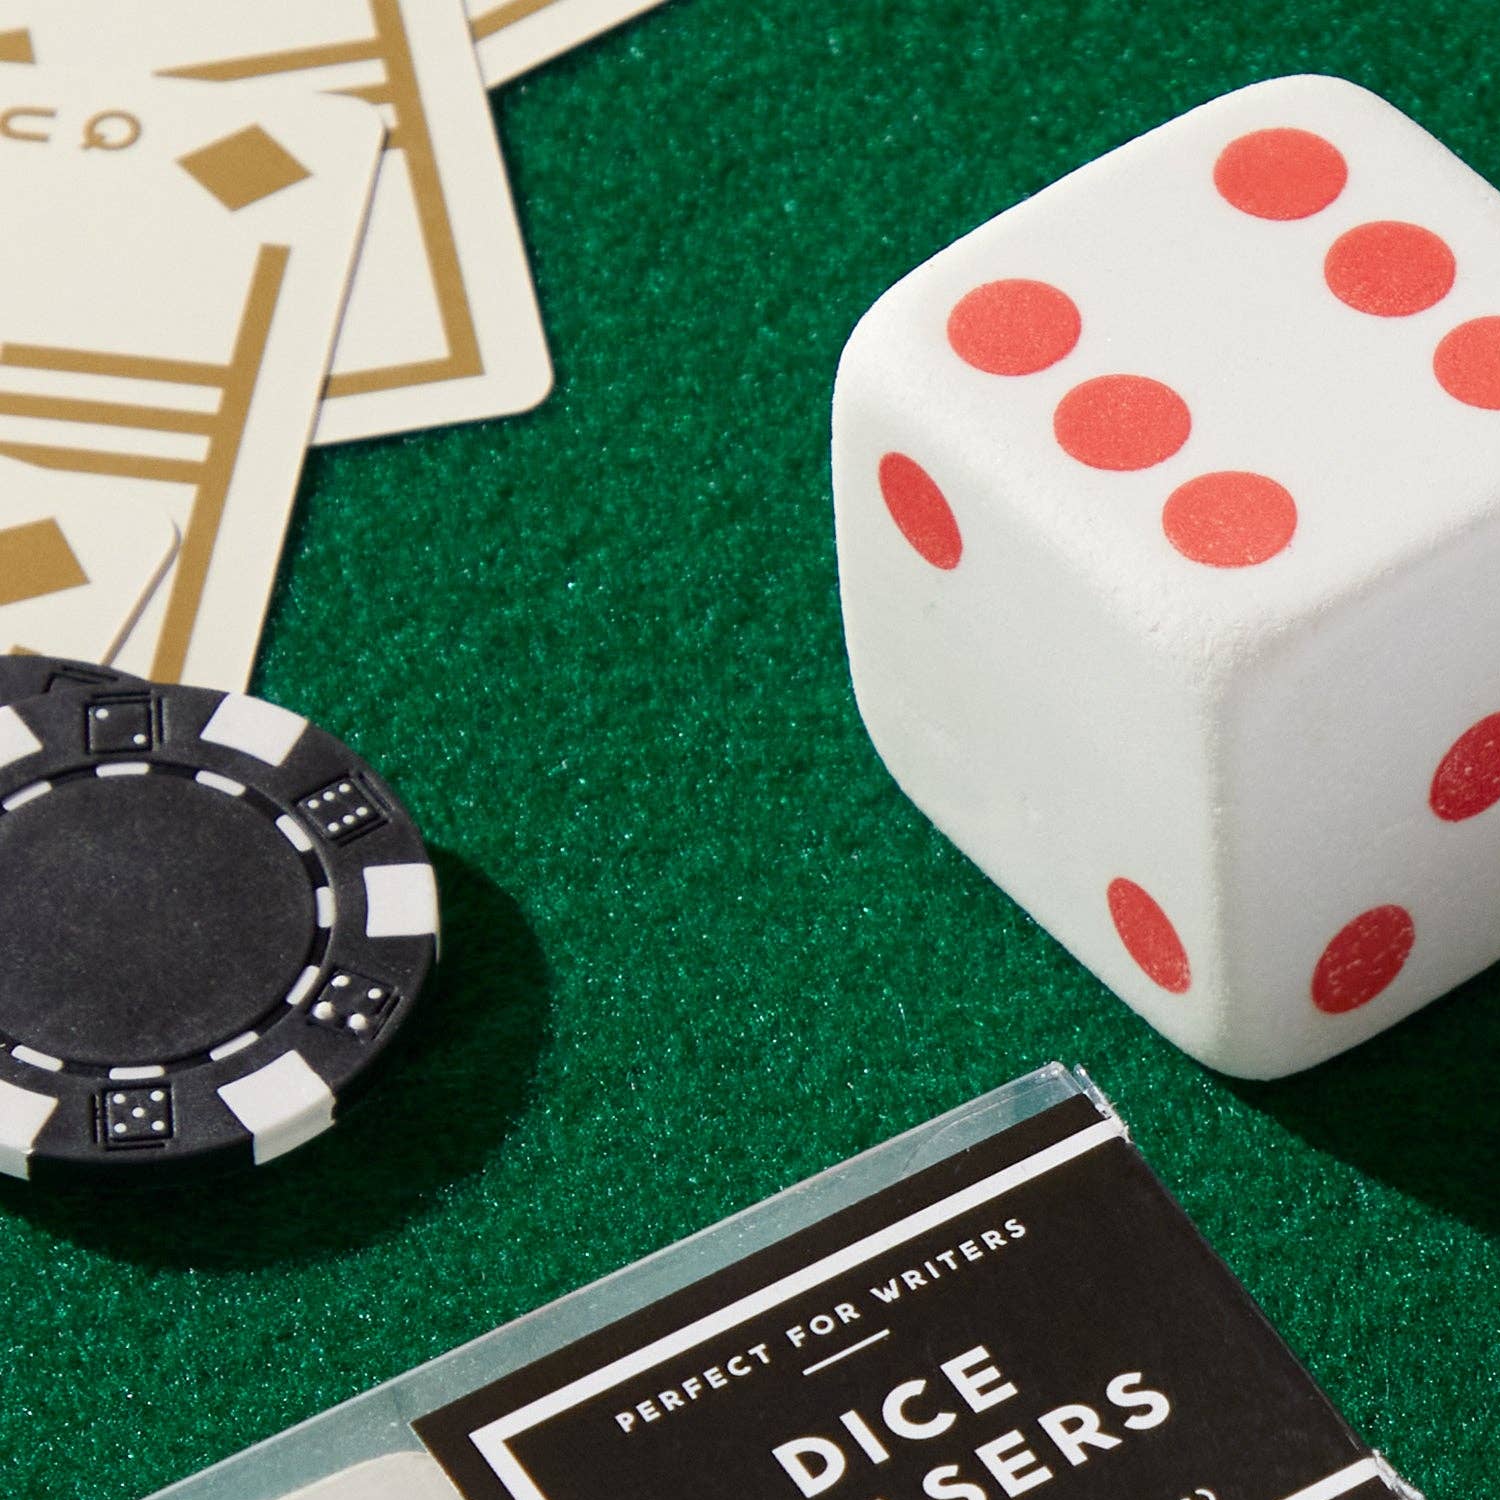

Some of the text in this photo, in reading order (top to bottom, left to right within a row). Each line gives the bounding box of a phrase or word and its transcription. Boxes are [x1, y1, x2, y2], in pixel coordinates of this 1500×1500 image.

[614, 1217, 1027, 1433] PERFECT FOR WRITERS
[771, 1344, 1019, 1499] DICE
